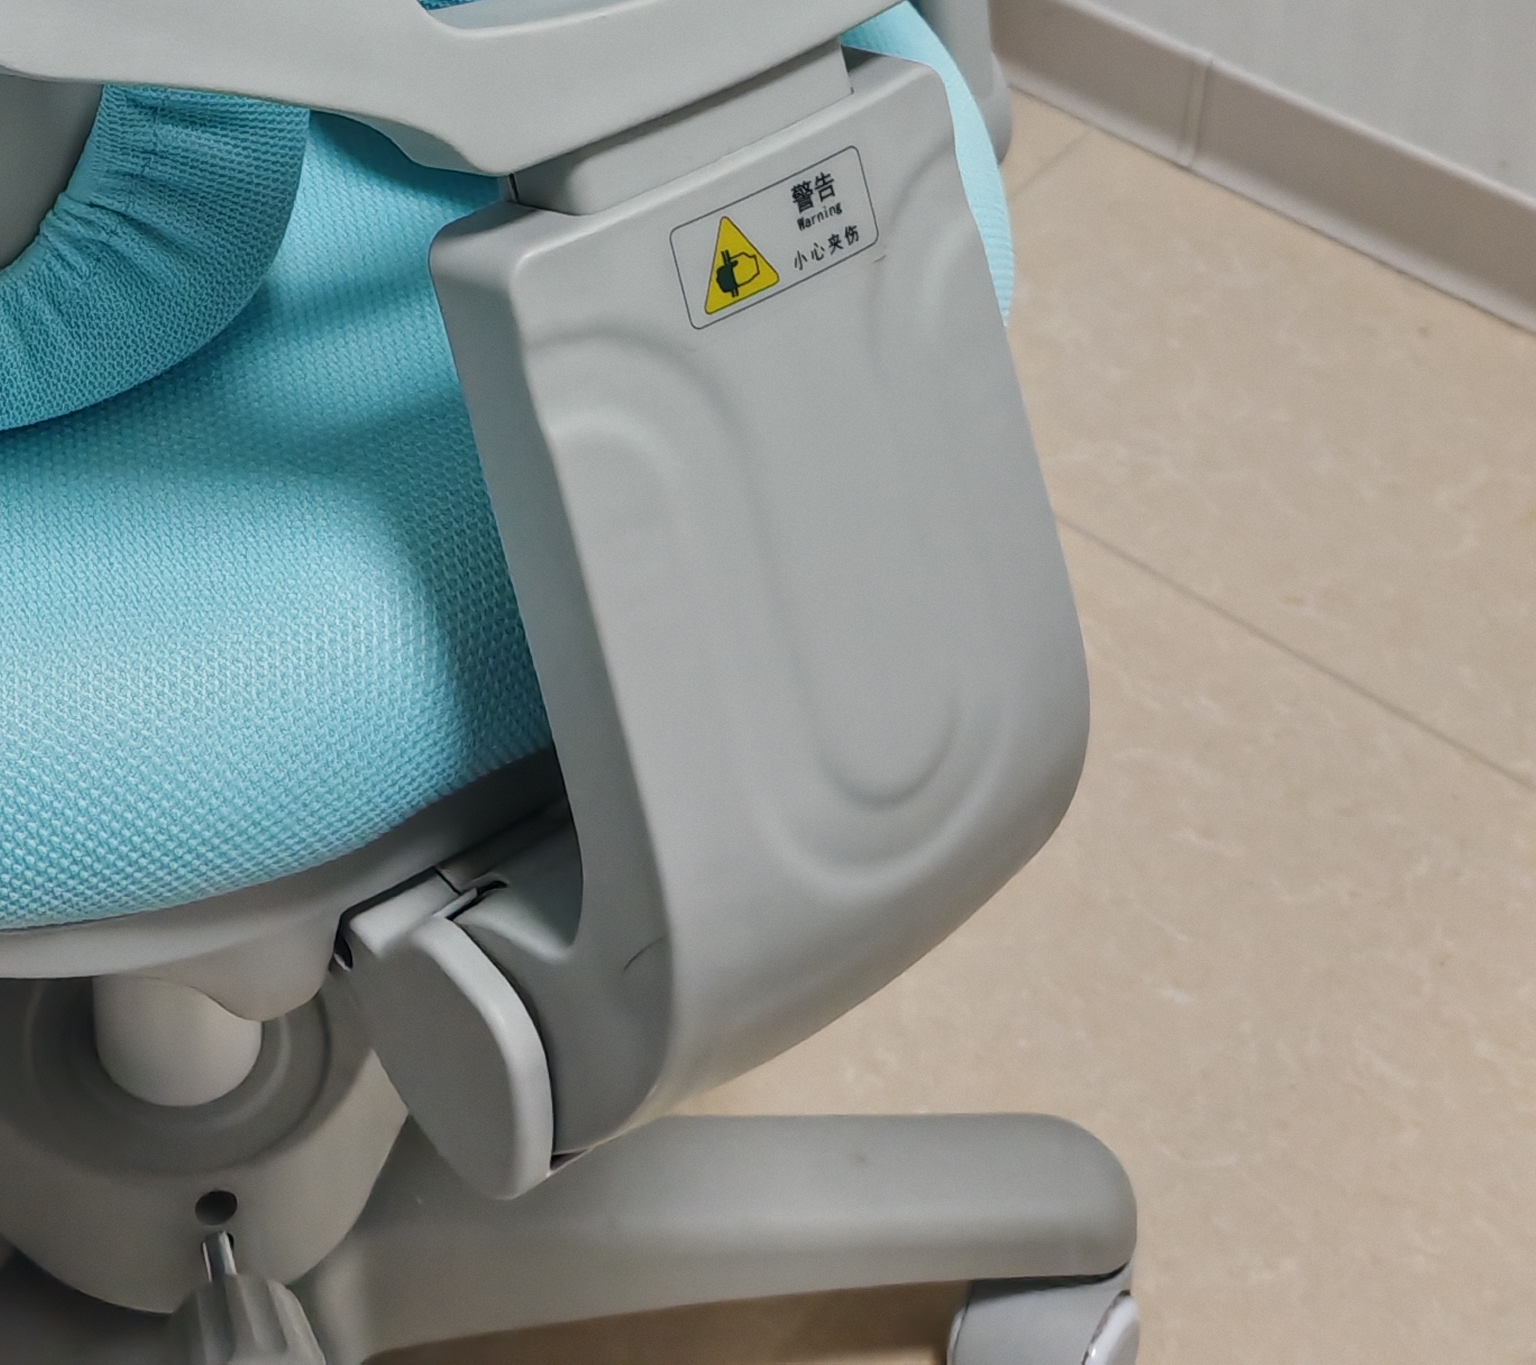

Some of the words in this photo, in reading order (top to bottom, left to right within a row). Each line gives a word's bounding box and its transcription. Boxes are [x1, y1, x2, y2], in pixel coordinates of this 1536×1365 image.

[791, 172, 835, 213] 警告
[797, 202, 843, 231] Warning
[793, 224, 860, 271] 小心夹伤
